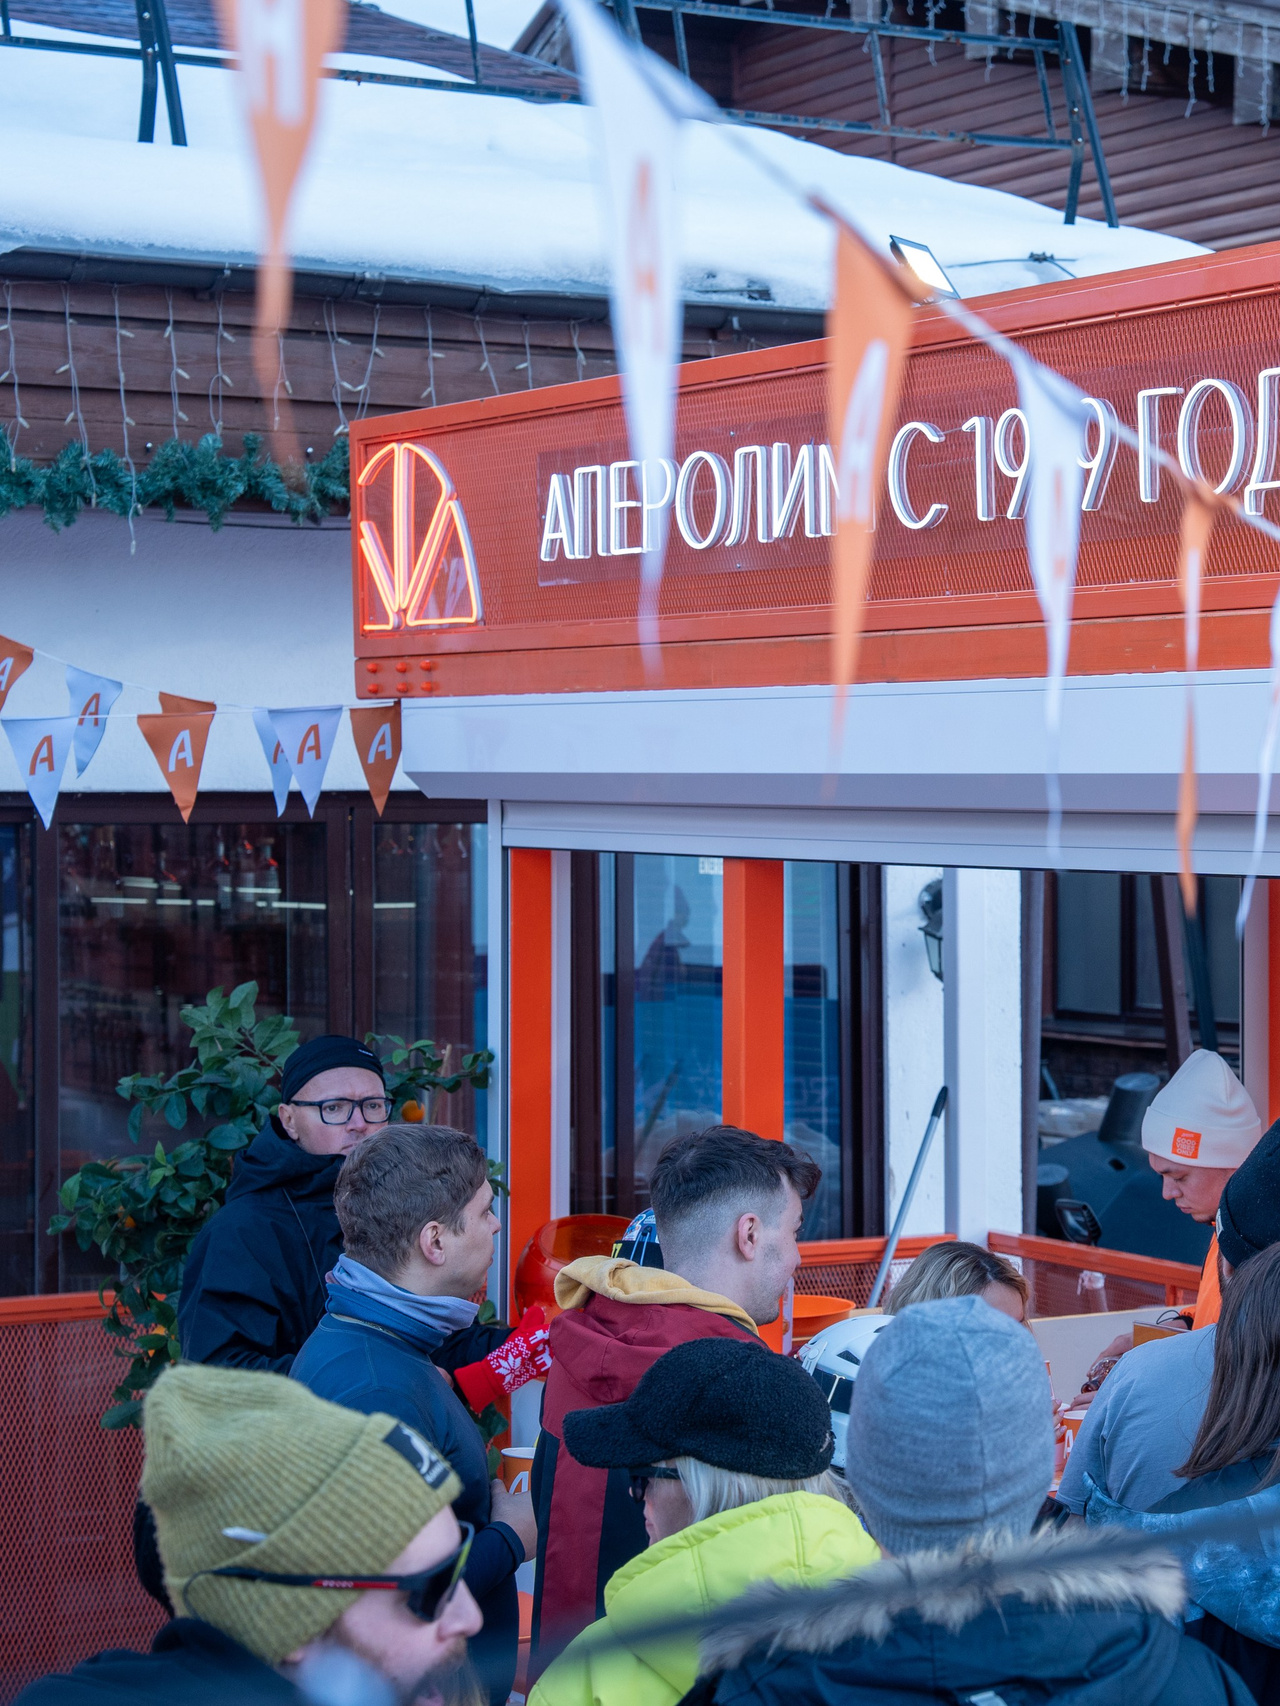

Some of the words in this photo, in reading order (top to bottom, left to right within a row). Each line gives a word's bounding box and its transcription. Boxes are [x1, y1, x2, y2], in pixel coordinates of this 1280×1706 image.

[888, 421, 949, 530] С
[961, 397, 1119, 521] 199
[78, 693, 101, 727] A
[29, 734, 55, 776] A
[168, 729, 194, 773] A
[297, 723, 322, 765] A
[367, 722, 393, 764] A
[1176, 1137, 1197, 1147] GOOD
